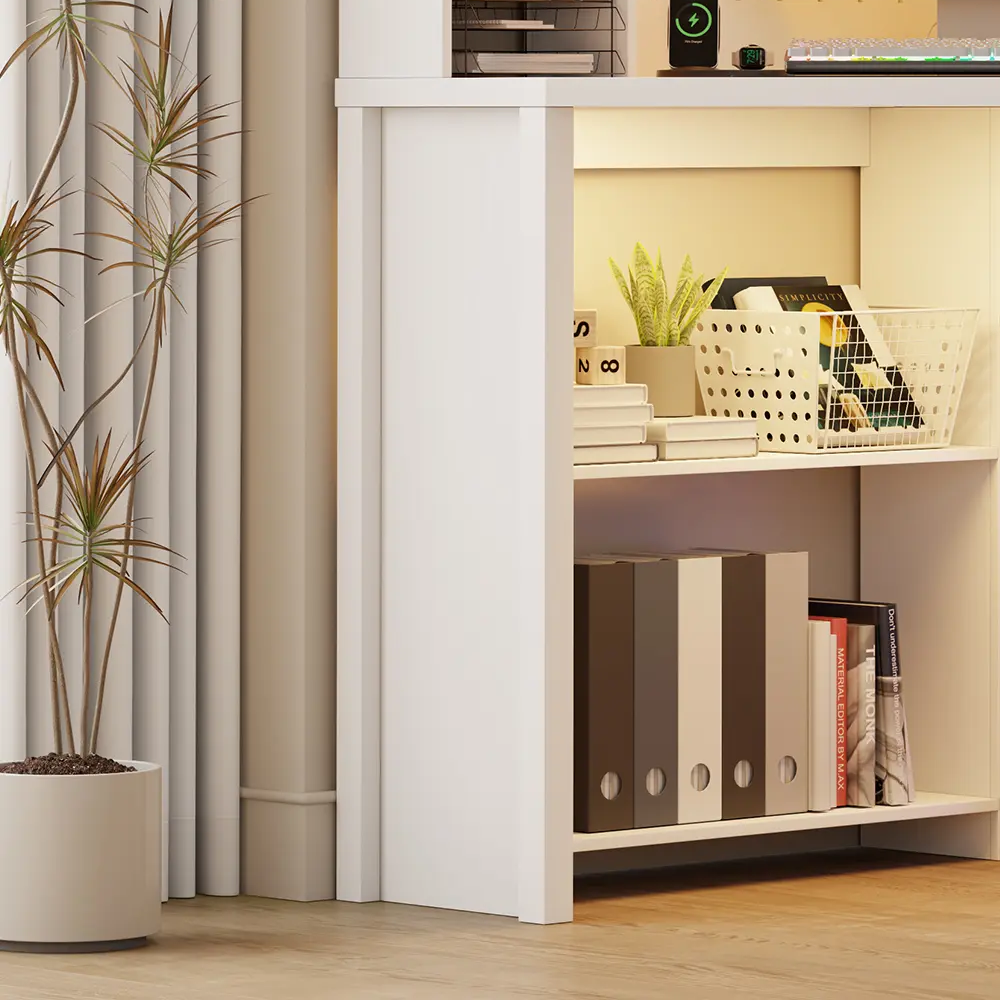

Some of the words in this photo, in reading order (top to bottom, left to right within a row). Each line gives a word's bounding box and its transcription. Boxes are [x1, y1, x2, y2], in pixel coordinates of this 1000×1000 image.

[778, 293, 843, 301] SIMPLICITY
[578, 358, 590, 373] 2
[600, 359, 620, 373] 8
[888, 608, 897, 631] Don't
[837, 648, 845, 701] MATERIAL
[865, 644, 876, 683] THE
[889, 632, 900, 692] underestimate
[837, 703, 845, 744] EDITOR
[865, 687, 876, 745] MONK
[837, 745, 845, 764] BY
